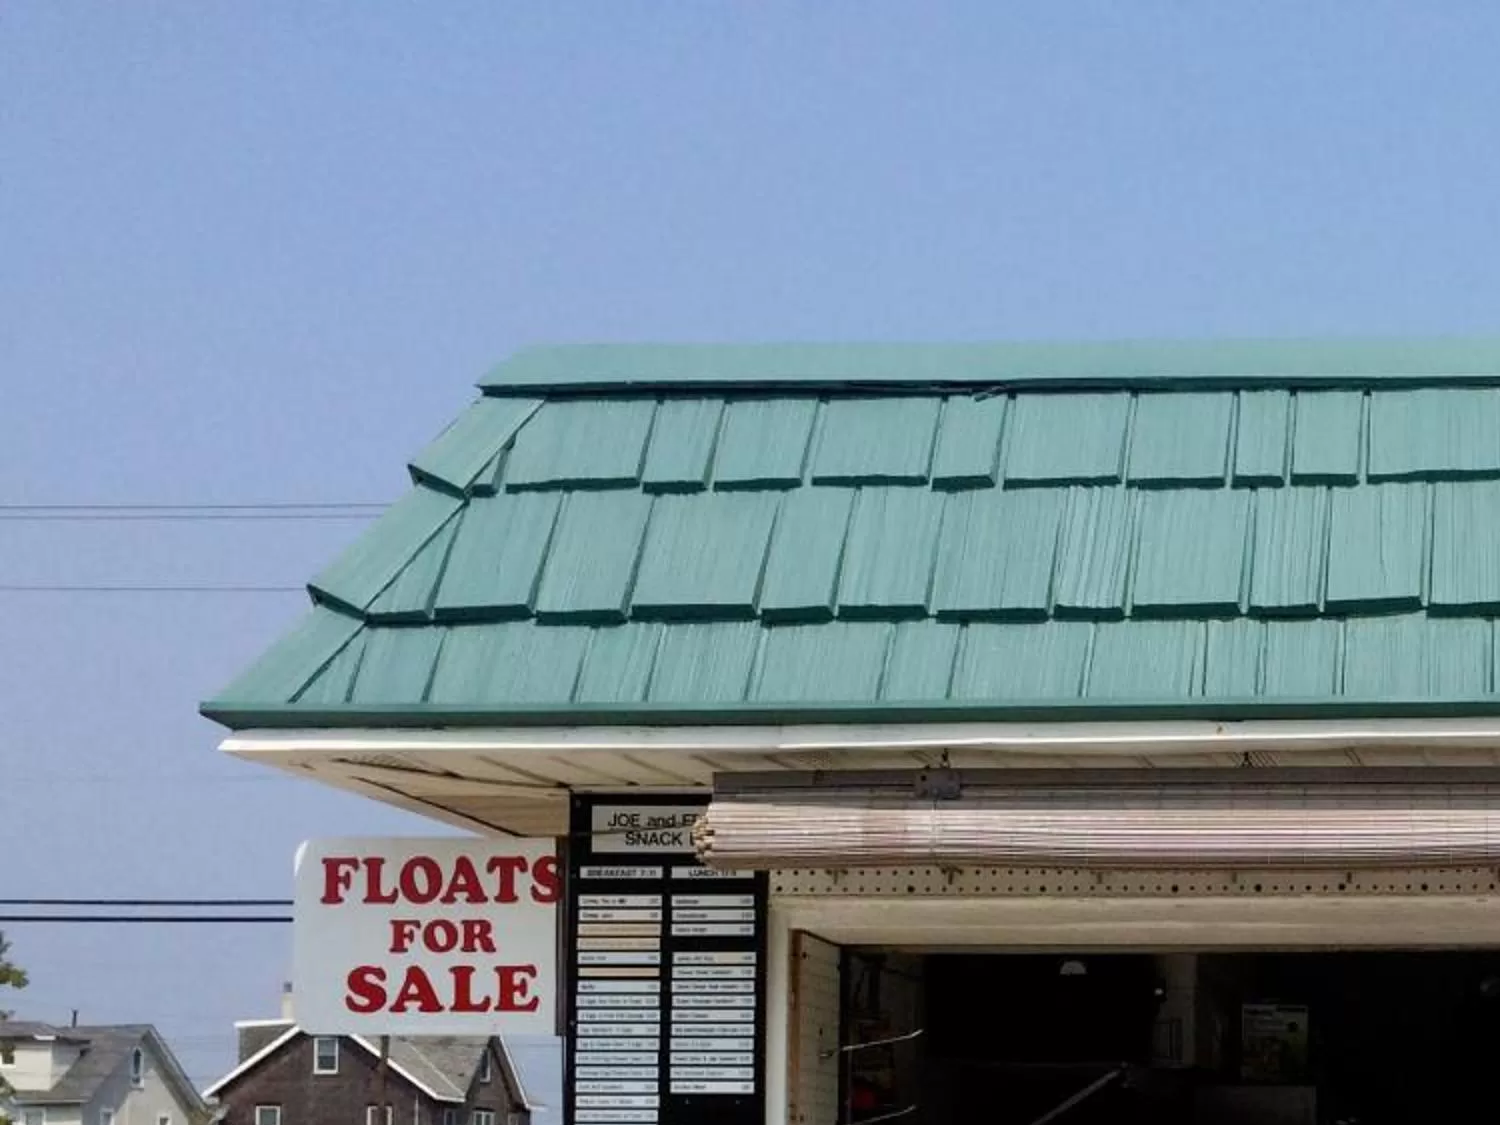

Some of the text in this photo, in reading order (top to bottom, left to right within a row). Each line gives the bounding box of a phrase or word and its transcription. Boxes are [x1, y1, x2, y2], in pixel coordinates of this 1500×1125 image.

[607, 812, 641, 828] JOE
[647, 813, 677, 828] and
[625, 831, 683, 847] SNACK
[320, 855, 565, 904] FLOATS
[389, 918, 497, 954] FOR
[345, 964, 541, 1015] SALE
